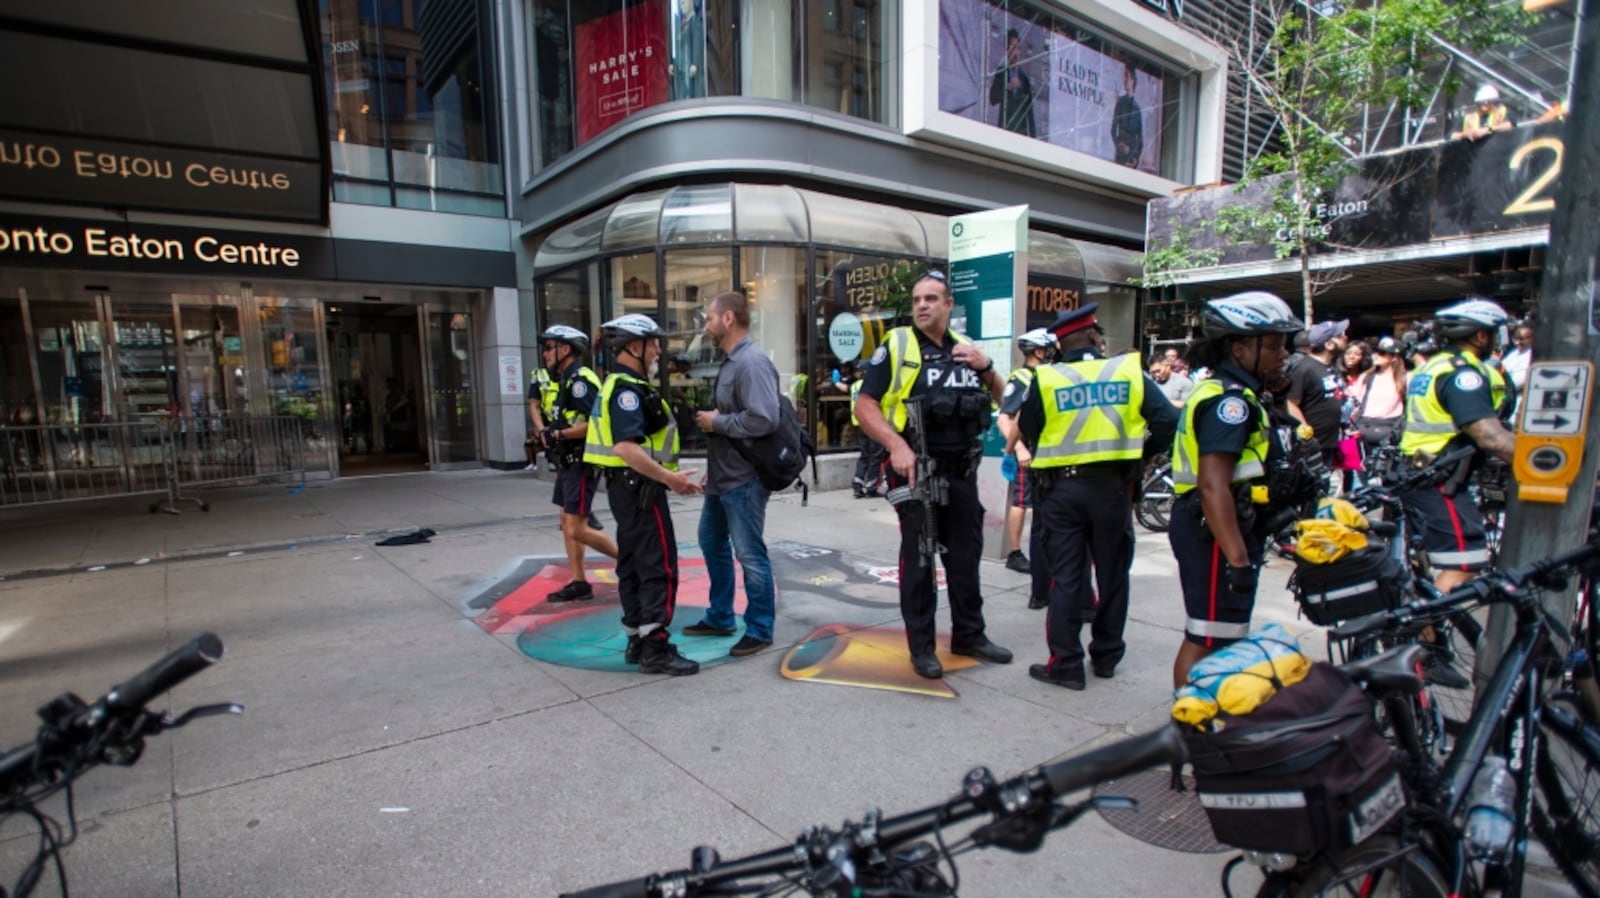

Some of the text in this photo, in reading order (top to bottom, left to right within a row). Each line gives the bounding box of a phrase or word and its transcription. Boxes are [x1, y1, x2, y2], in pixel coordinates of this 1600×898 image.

[589, 46, 652, 74] HARRY'S
[1059, 58, 1098, 87] LEAD BY
[603, 65, 639, 84] SALE
[1503, 137, 1565, 216] 2
[1316, 200, 1368, 219] Eaton
[85, 229, 184, 260] Eaton
[194, 236, 300, 267] Centre
[1026, 285, 1079, 312] m0851
[838, 338, 856, 346] SALE
[927, 367, 980, 388] PLICE
[1057, 380, 1128, 410] POLICE
